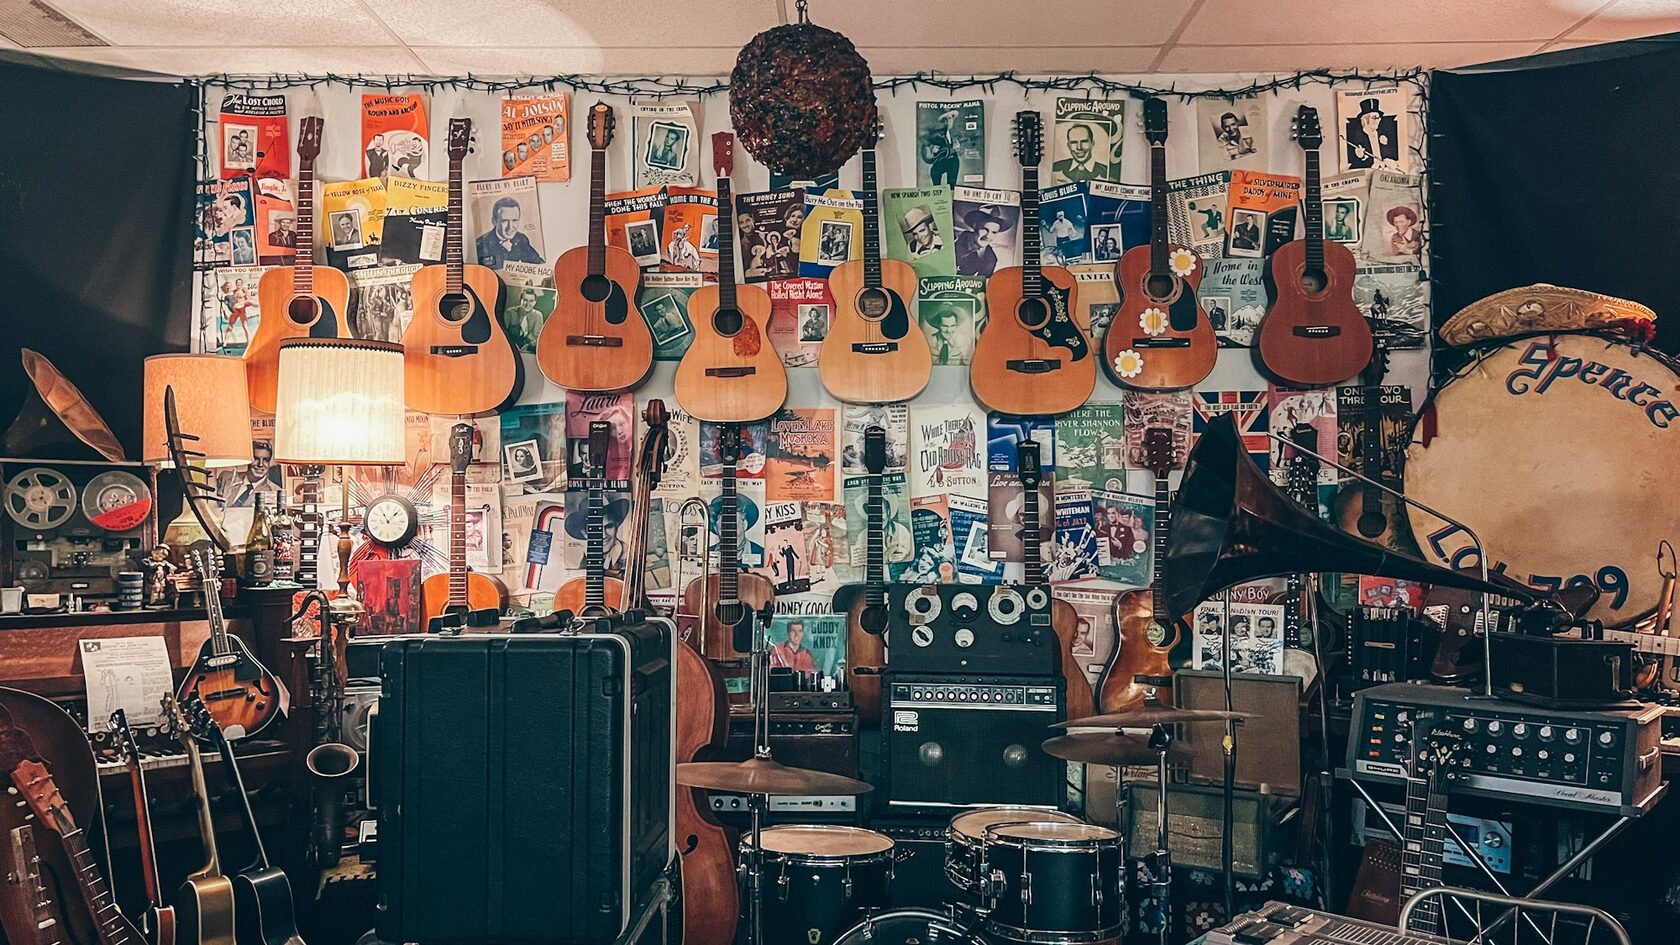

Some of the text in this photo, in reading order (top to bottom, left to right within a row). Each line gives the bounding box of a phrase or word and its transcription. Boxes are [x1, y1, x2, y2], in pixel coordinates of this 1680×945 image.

[243, 96, 260, 106] LOST
[262, 98, 284, 106] CHORD
[364, 101, 374, 110] THE
[374, 97, 394, 105] MUSIC
[389, 108, 400, 116] AND
[502, 100, 564, 118] AL JOLSON
[1057, 99, 1120, 115] SLIPPING AROUND
[394, 180, 418, 190] DIZZY
[1169, 172, 1224, 190] THE THING
[331, 190, 350, 198] YELLOW
[756, 193, 777, 202] HONEY
[778, 192, 796, 200] SONG
[1042, 184, 1078, 202] LOUIS BLUES
[1244, 187, 1265, 196] DADDY
[1273, 192, 1292, 200] MINE
[604, 200, 622, 208] WHEN
[670, 196, 686, 204] HOME
[700, 197, 711, 205] THE
[826, 198, 838, 206] Out
[633, 203, 648, 211] THIS
[505, 264, 536, 275] MY ADOBE
[1213, 260, 1258, 275] Home in
[770, 281, 782, 290] The
[782, 281, 804, 290] Covered
[1222, 274, 1237, 286] the
[920, 278, 983, 295] SLIPPING AROUND
[770, 290, 824, 300] Rolled Right Along
[1506, 341, 1680, 429] Spence
[1339, 396, 1365, 405] THRE
[1380, 395, 1410, 404] OUR
[570, 394, 621, 417] Laura
[672, 409, 693, 424] WIFE
[1096, 409, 1111, 417] THE
[262, 419, 276, 428] BLUE
[771, 418, 808, 432] LOVELY
[808, 418, 834, 432] LAKE
[1056, 420, 1120, 428] RIVER SHANNON
[779, 432, 829, 450] MUSKOKA
[942, 433, 948, 444] A
[920, 450, 938, 472] OLD
[946, 476, 976, 487] SUTTON
[990, 475, 1008, 487] Live
[960, 500, 980, 508] WALKING
[776, 504, 796, 518] KISS
[1056, 506, 1090, 516] WHITEMAN
[1072, 518, 1088, 526] JAZZ
[811, 621, 840, 634] BUDDY
[813, 636, 838, 648] KNOX
[894, 724, 918, 732] Roland
[1368, 766, 1399, 774] SHURE
